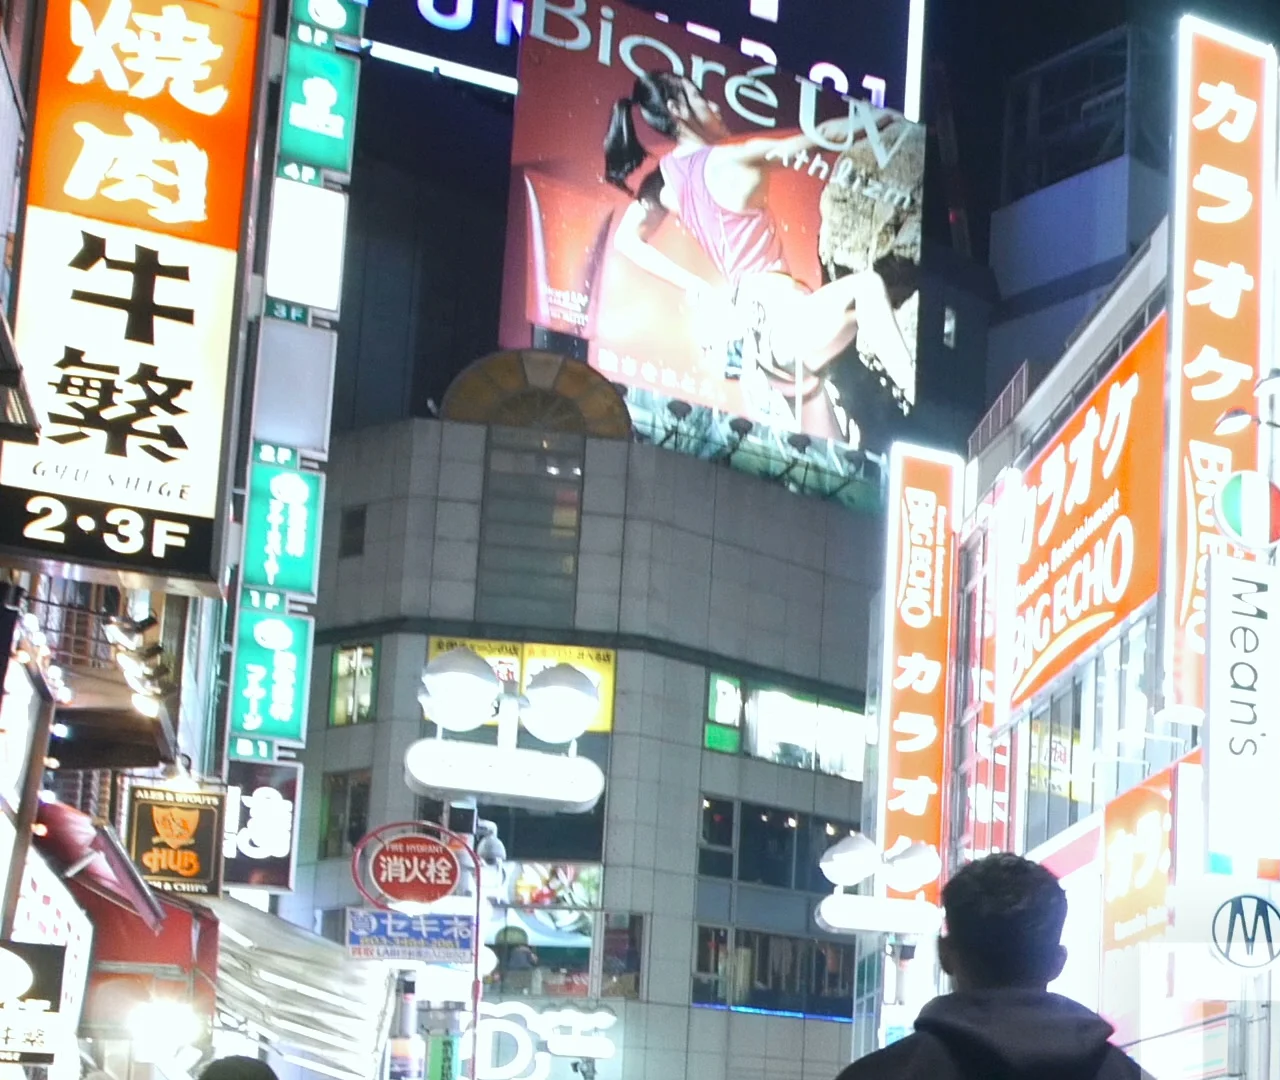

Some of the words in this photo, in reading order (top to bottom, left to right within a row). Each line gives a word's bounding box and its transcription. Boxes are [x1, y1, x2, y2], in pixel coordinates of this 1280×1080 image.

[64, 0, 229, 224] 焼肉
[527, 0, 779, 129] Bioré
[796, 74, 918, 171] UV
[1184, 80, 1258, 403] カラオケ
[1052, 515, 1135, 635] ECHO
[1227, 576, 1270, 758] Mean's
[141, 847, 200, 878] HUB
[379, 854, 452, 885] 消火栓
